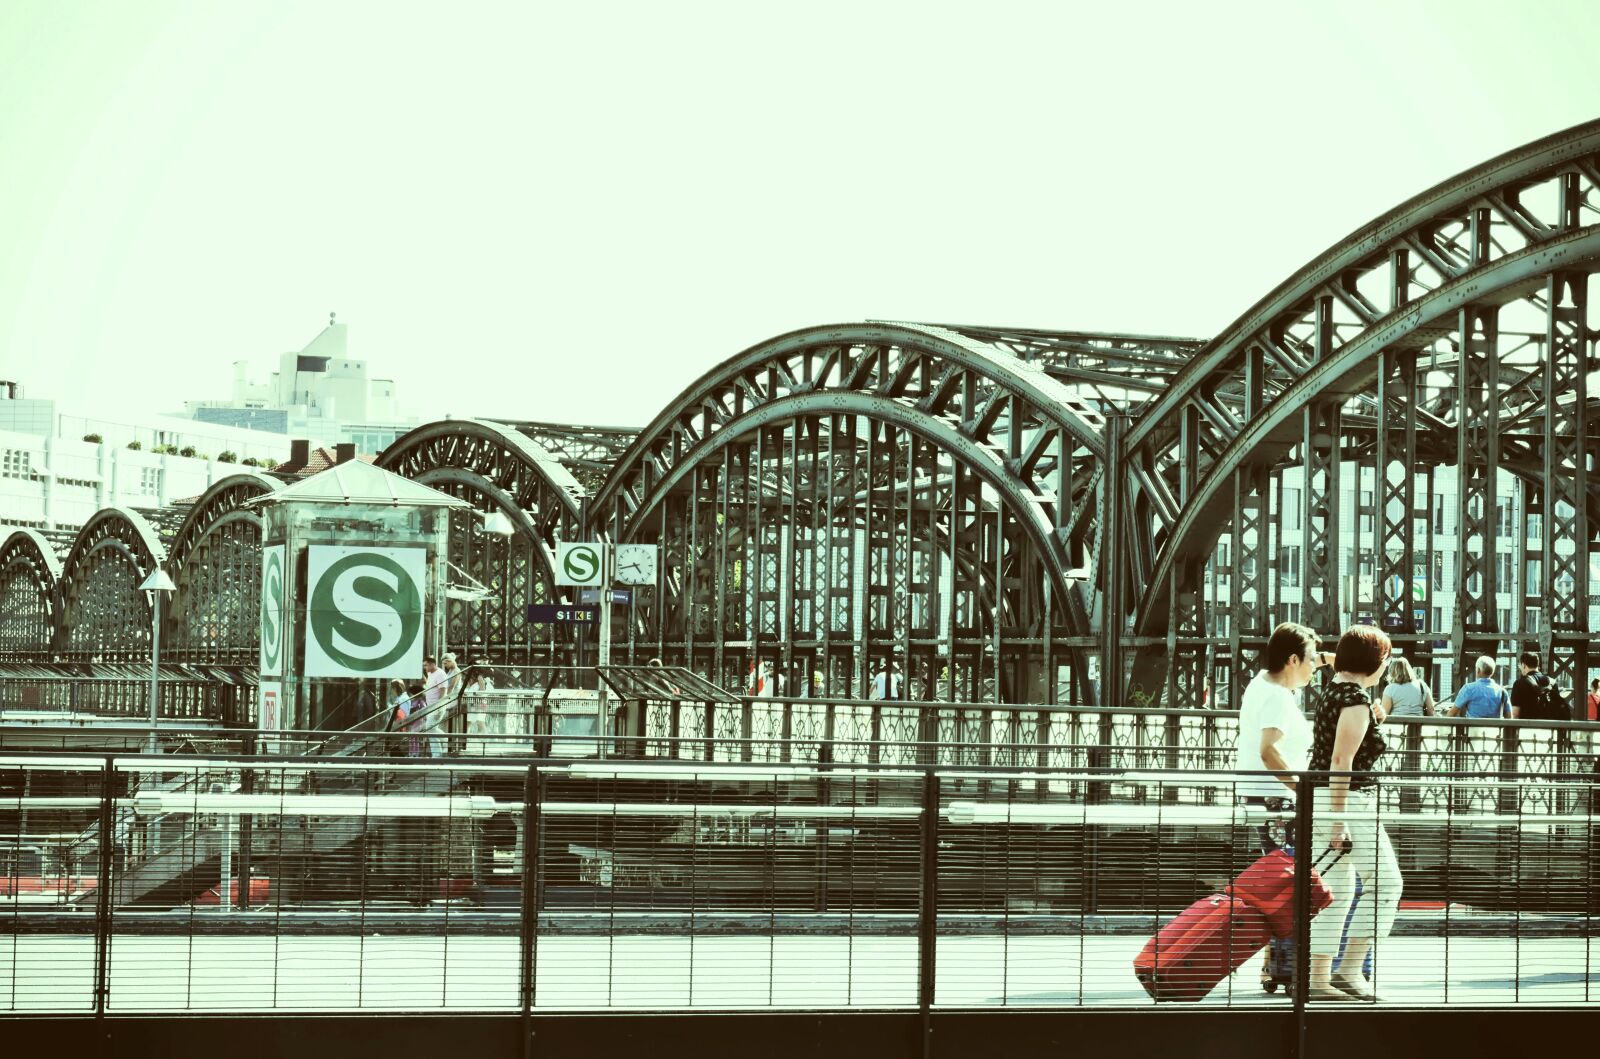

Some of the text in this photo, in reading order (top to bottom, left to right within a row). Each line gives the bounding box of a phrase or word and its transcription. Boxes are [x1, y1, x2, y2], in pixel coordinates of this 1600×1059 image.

[567, 546, 595, 581] S
[331, 564, 403, 661] S
[265, 699, 276, 730] DB
